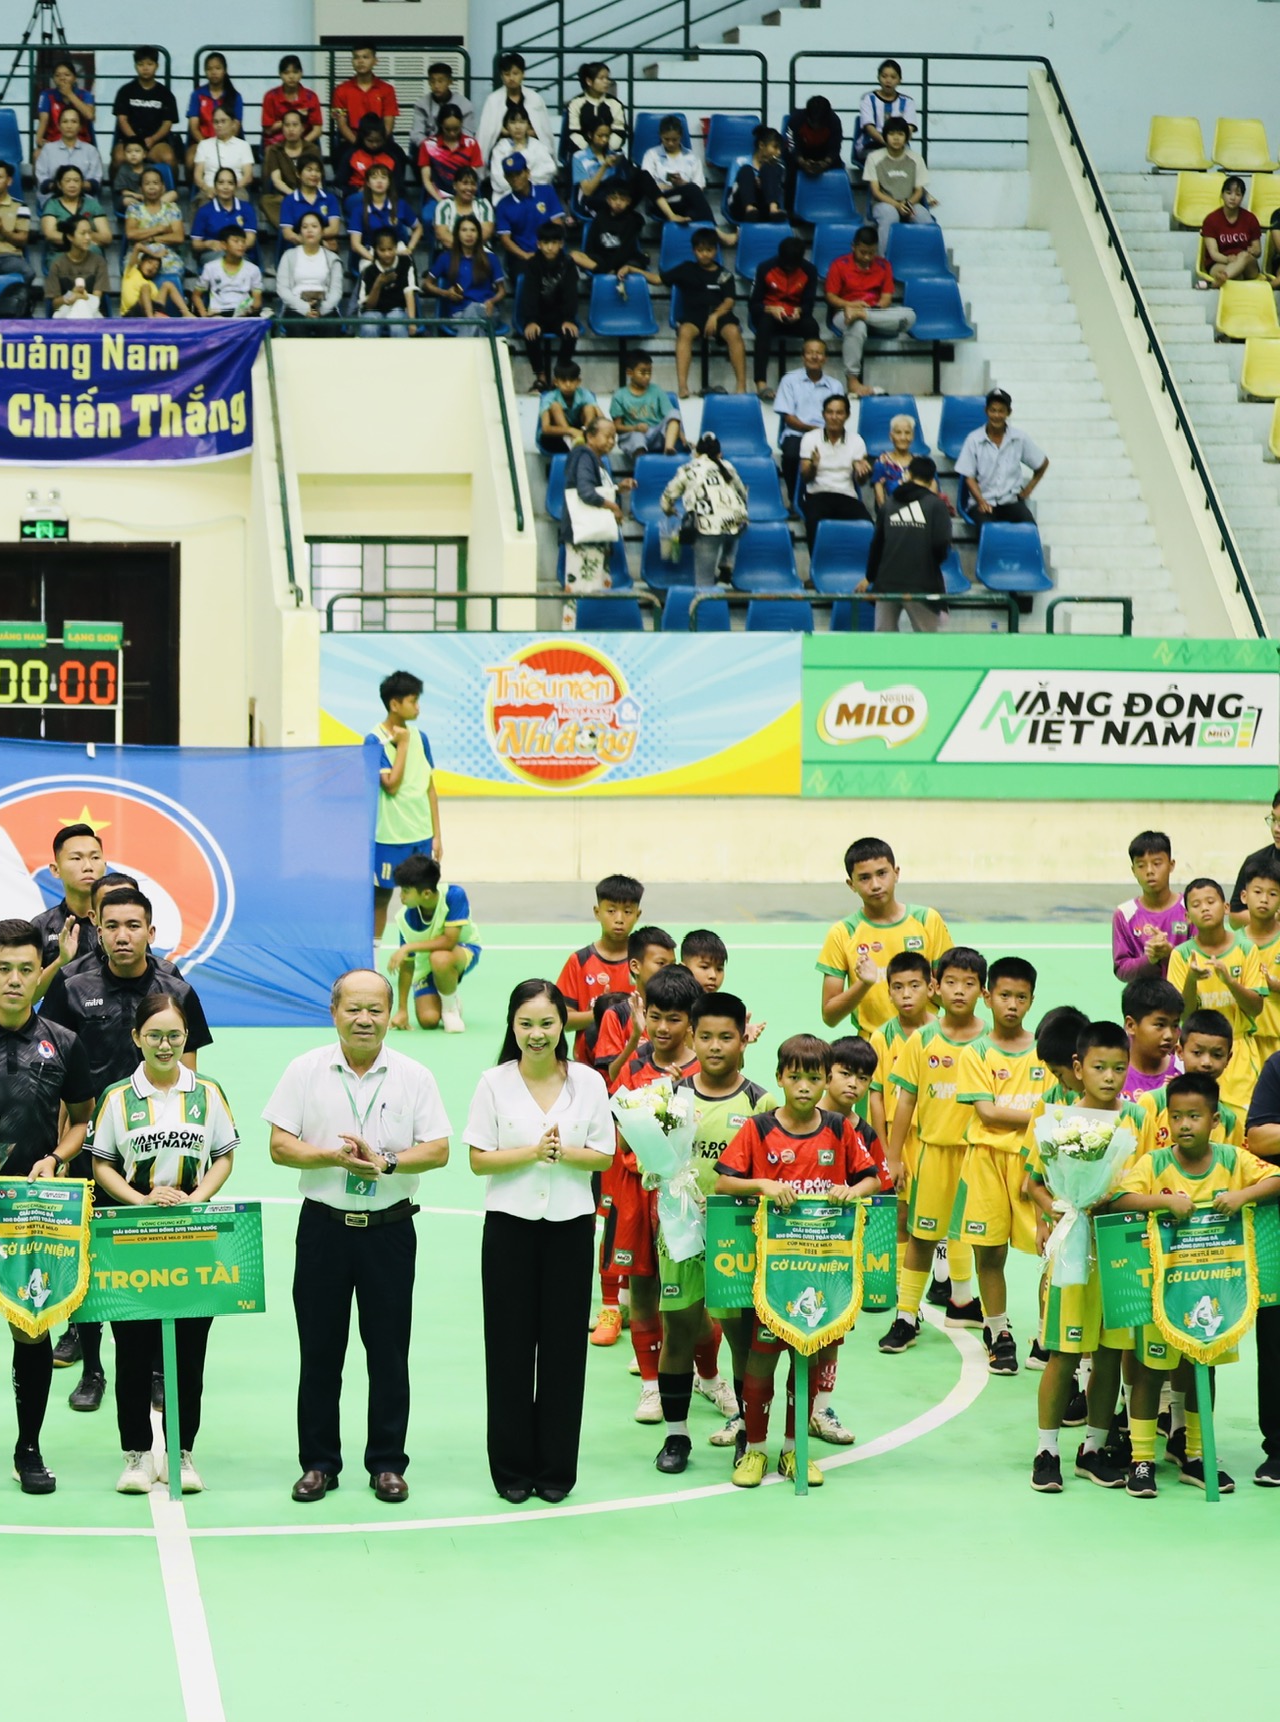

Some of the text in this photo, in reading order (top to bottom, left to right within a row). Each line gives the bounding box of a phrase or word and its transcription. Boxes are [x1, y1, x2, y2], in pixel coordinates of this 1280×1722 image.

[1219, 232, 1248, 243] GUCCI
[102, 333, 180, 372] Nam
[7, 386, 122, 439] Chiến
[131, 384, 248, 439] Thắng
[24, 633, 45, 641] NAM
[834, 703, 915, 727] MILO
[1102, 720, 1196, 746] NAM
[44, 1243, 76, 1260] NIỆM
[770, 1258, 849, 1275] CỜ LƯU NIỆM
[1167, 1270, 1182, 1283] CỜ
[1184, 1269, 1210, 1282] LƯU
[1211, 1266, 1242, 1281] NIỆM
[94, 1261, 240, 1293] TRỌNG TÀI
